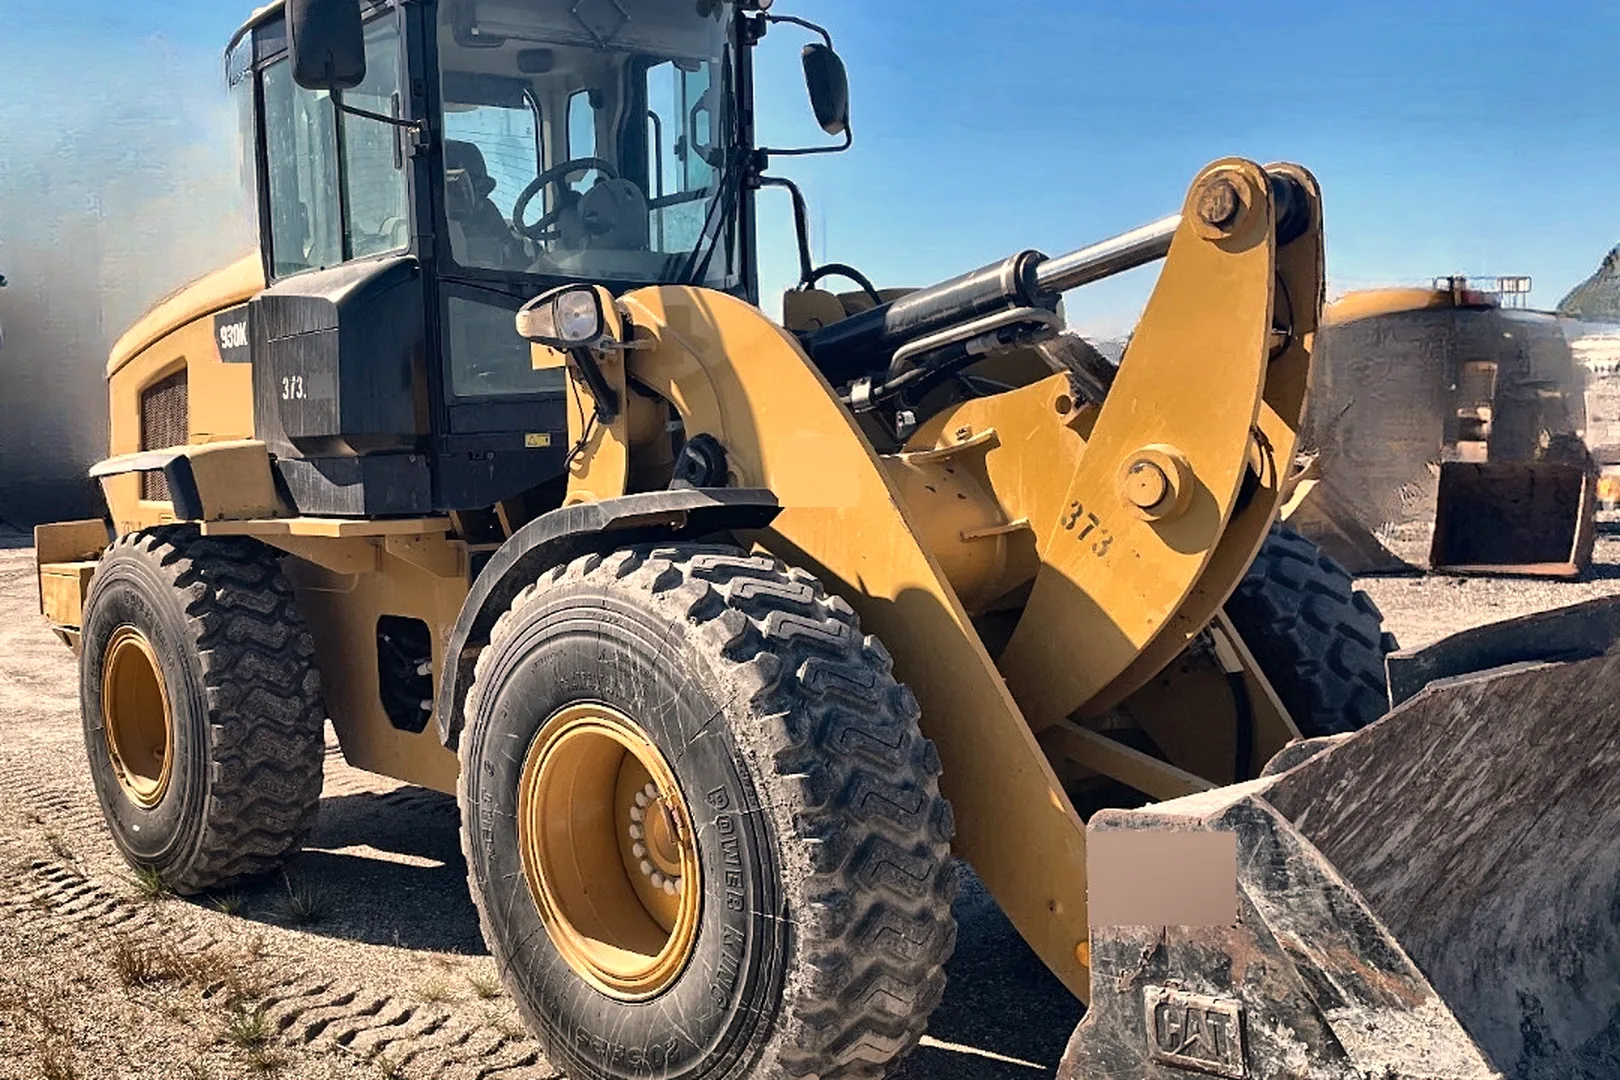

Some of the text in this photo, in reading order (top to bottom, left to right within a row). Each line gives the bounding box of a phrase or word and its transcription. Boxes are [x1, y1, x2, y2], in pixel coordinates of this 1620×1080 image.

[219, 320, 248, 349] 930K
[1060, 500, 1114, 558] 373
[707, 785, 746, 1010] POWER KING
[1154, 1001, 1232, 1062] CAT
